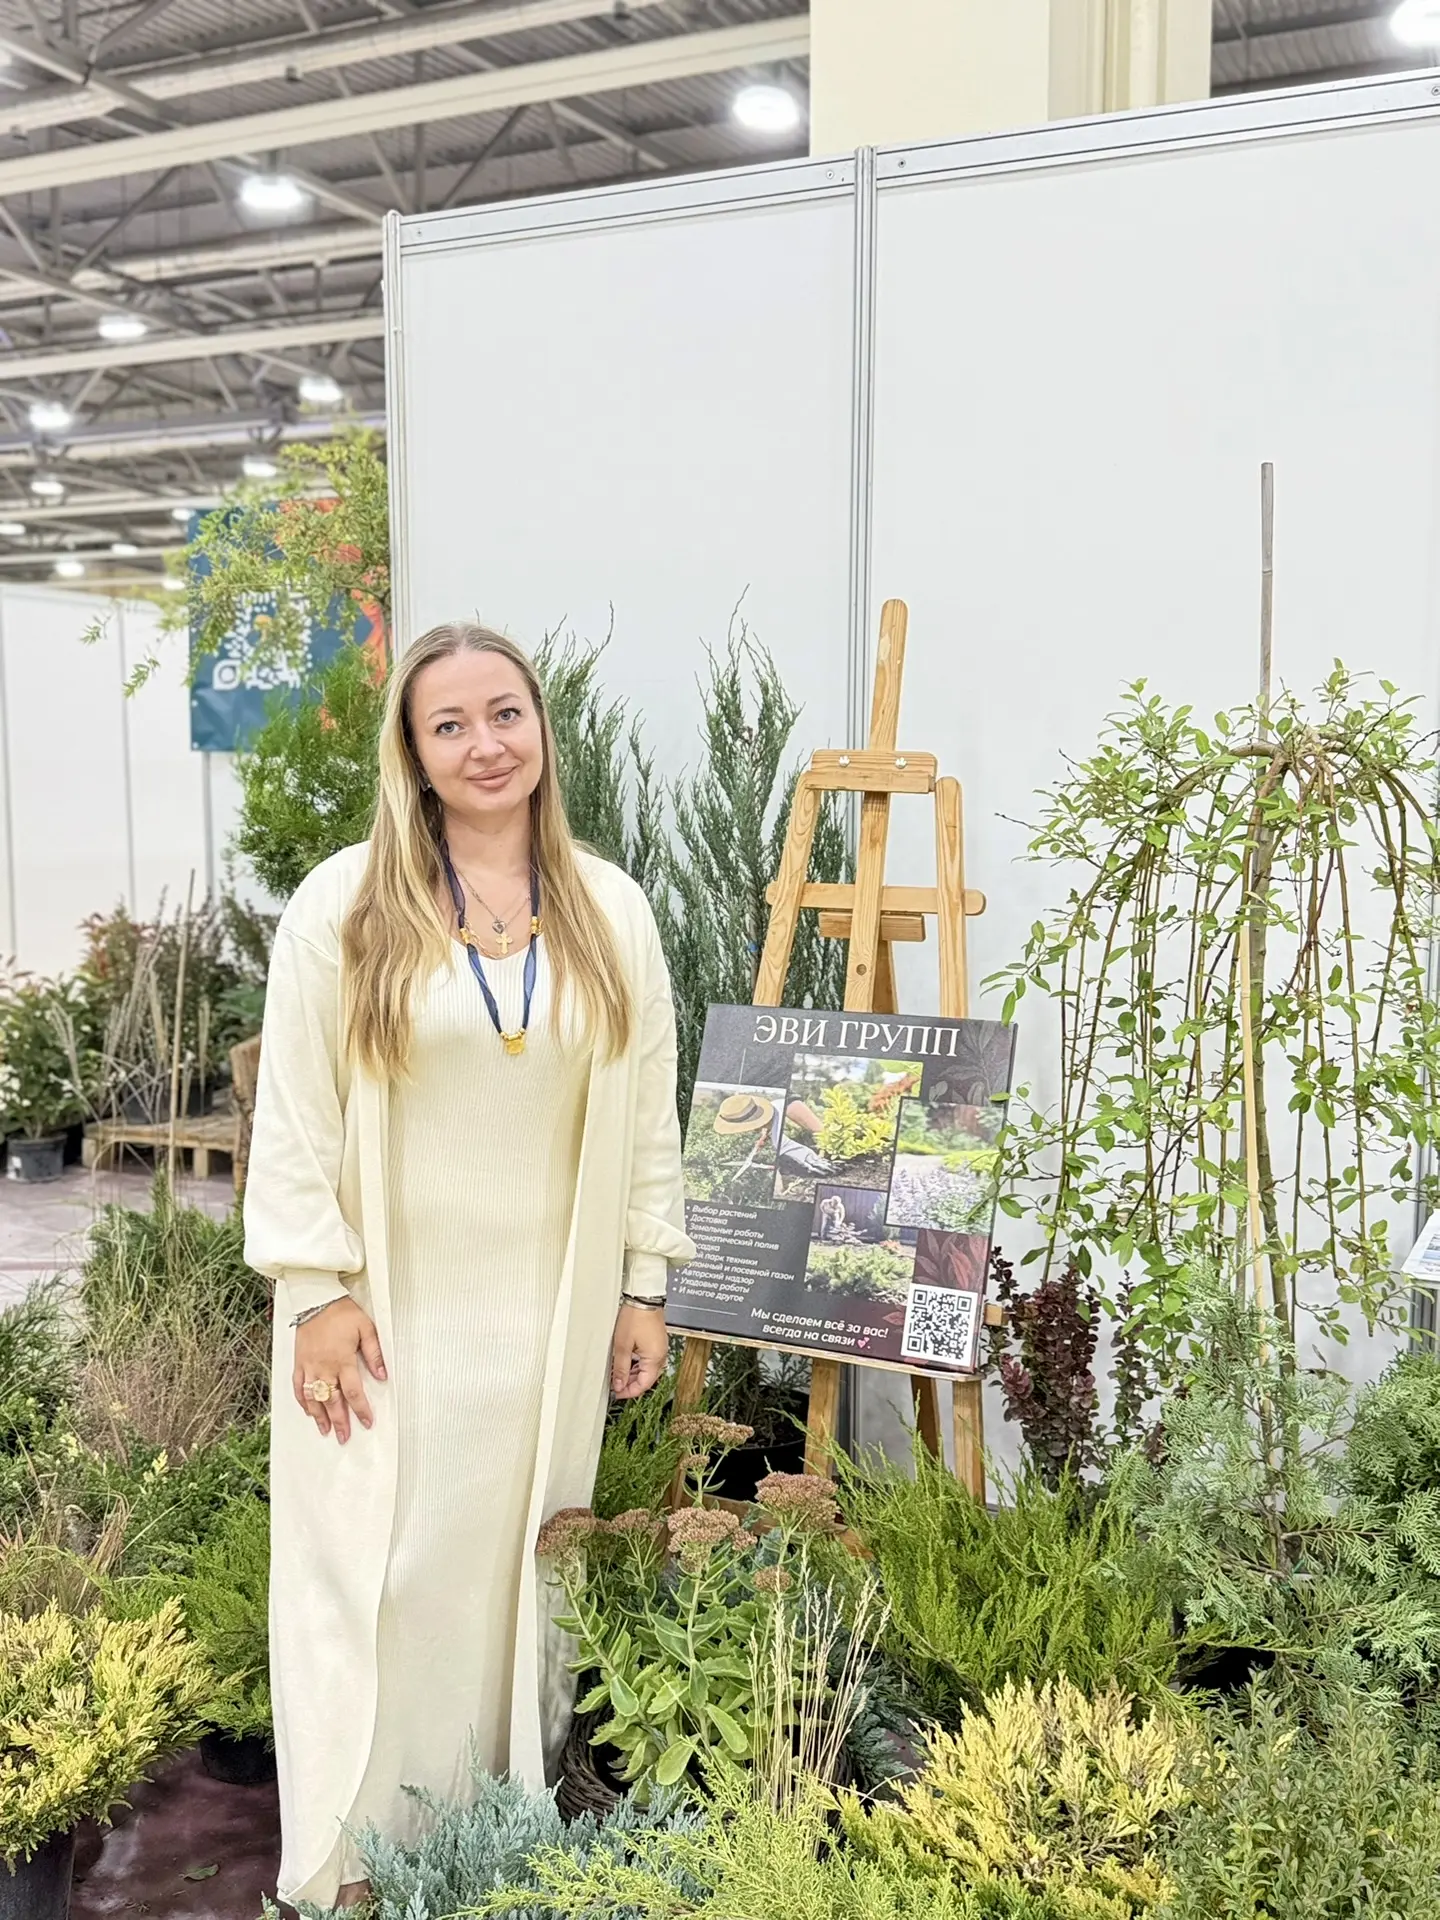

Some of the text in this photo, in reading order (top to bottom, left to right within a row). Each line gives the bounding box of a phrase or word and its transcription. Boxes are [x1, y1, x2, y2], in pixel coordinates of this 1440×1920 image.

[753, 1015, 961, 1057] ЭВИ ГРУПП
[690, 1214, 728, 1225] Доставка
[692, 1205, 757, 1219] Выбор растений
[689, 1222, 764, 1239] Земельные работы
[689, 1232, 779, 1250] Автоматический полив
[696, 1243, 720, 1252] садка
[705, 1253, 725, 1263] парк
[726, 1256, 758, 1266] техники
[681, 1268, 755, 1286] Авторский надзор
[683, 1261, 723, 1270] улонный
[731, 1266, 770, 1278] посевной
[771, 1271, 795, 1281] газон
[680, 1277, 750, 1293] Уходовые работы
[678, 1286, 744, 1302] И многое другое
[751, 1308, 889, 1338] Мы сделаем всё за вас!
[762, 1324, 856, 1346] всегда на связи
